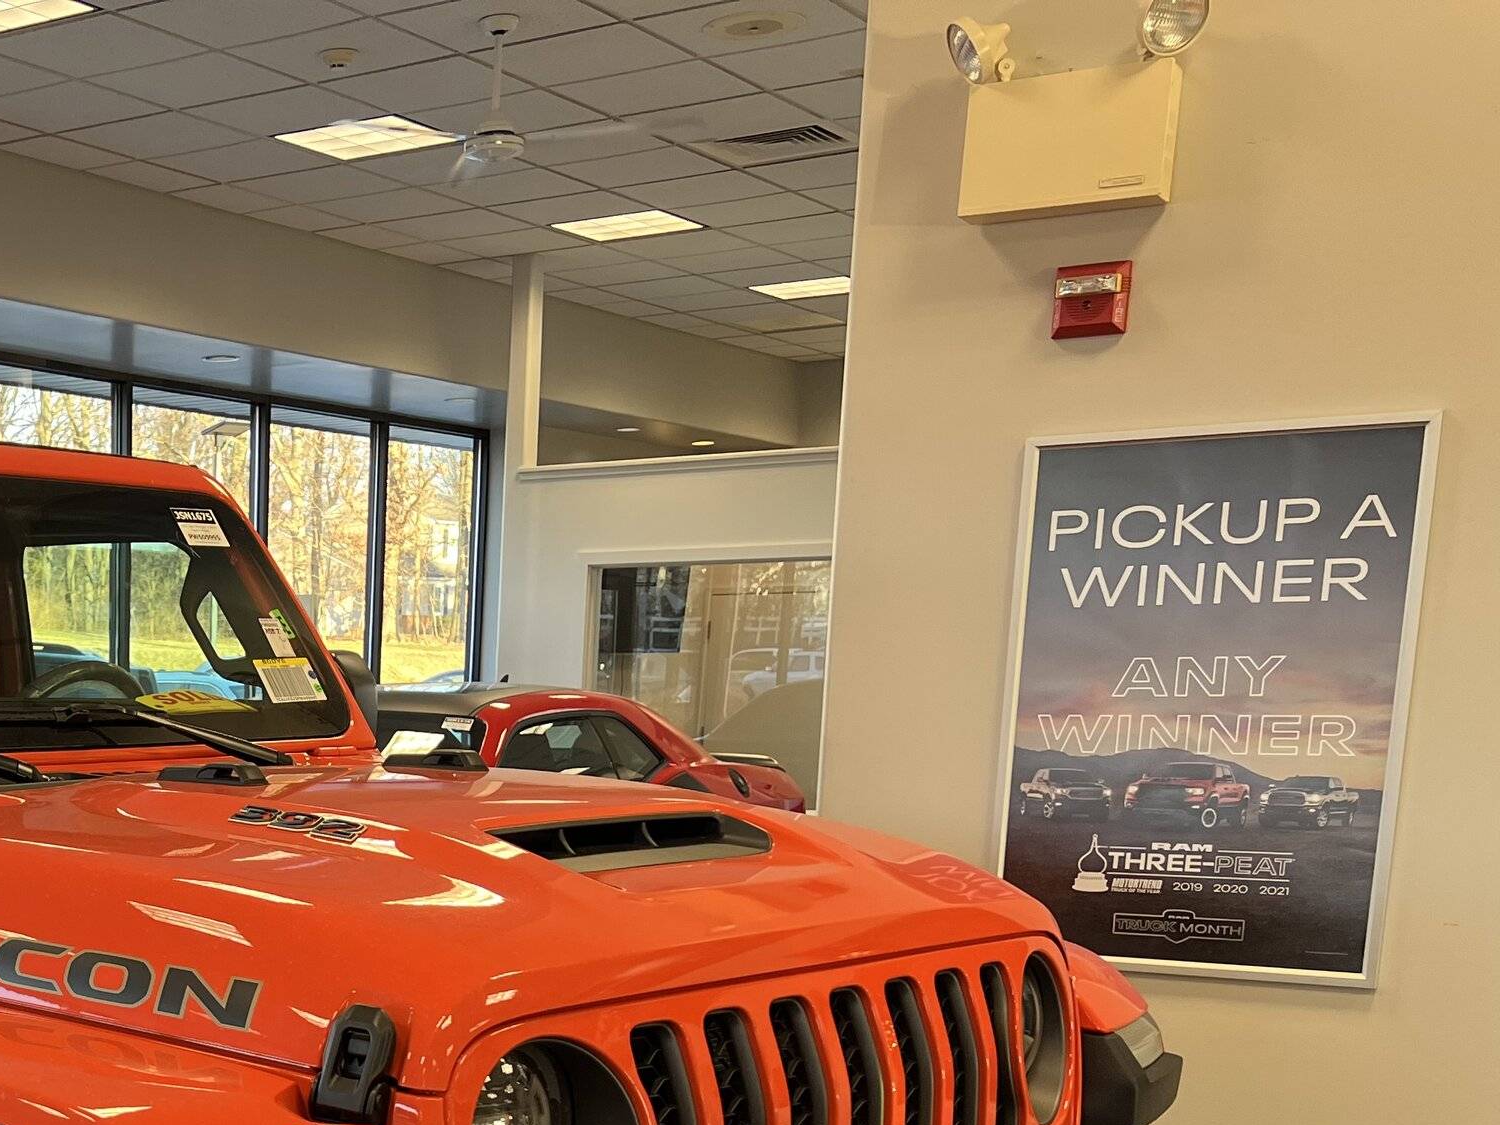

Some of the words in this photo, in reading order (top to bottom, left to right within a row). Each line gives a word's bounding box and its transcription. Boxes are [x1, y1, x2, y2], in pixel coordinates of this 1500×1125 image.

[1047, 497, 1322, 552] PICKUP
[1339, 494, 1398, 541] A
[1060, 557, 1369, 608] WINNER
[1111, 654, 1287, 698] ANY
[1037, 714, 1357, 757] WINNER
[228, 805, 368, 844] 392
[1108, 851, 1294, 877] THREE-PEAT
[1151, 842, 1213, 853] RAM
[1172, 881, 1203, 892] 2019
[1213, 883, 1248, 894] 2020
[1259, 885, 1290, 896] 2021
[1115, 918, 1178, 933] TRUCK
[1179, 922, 1242, 937] MONTH
